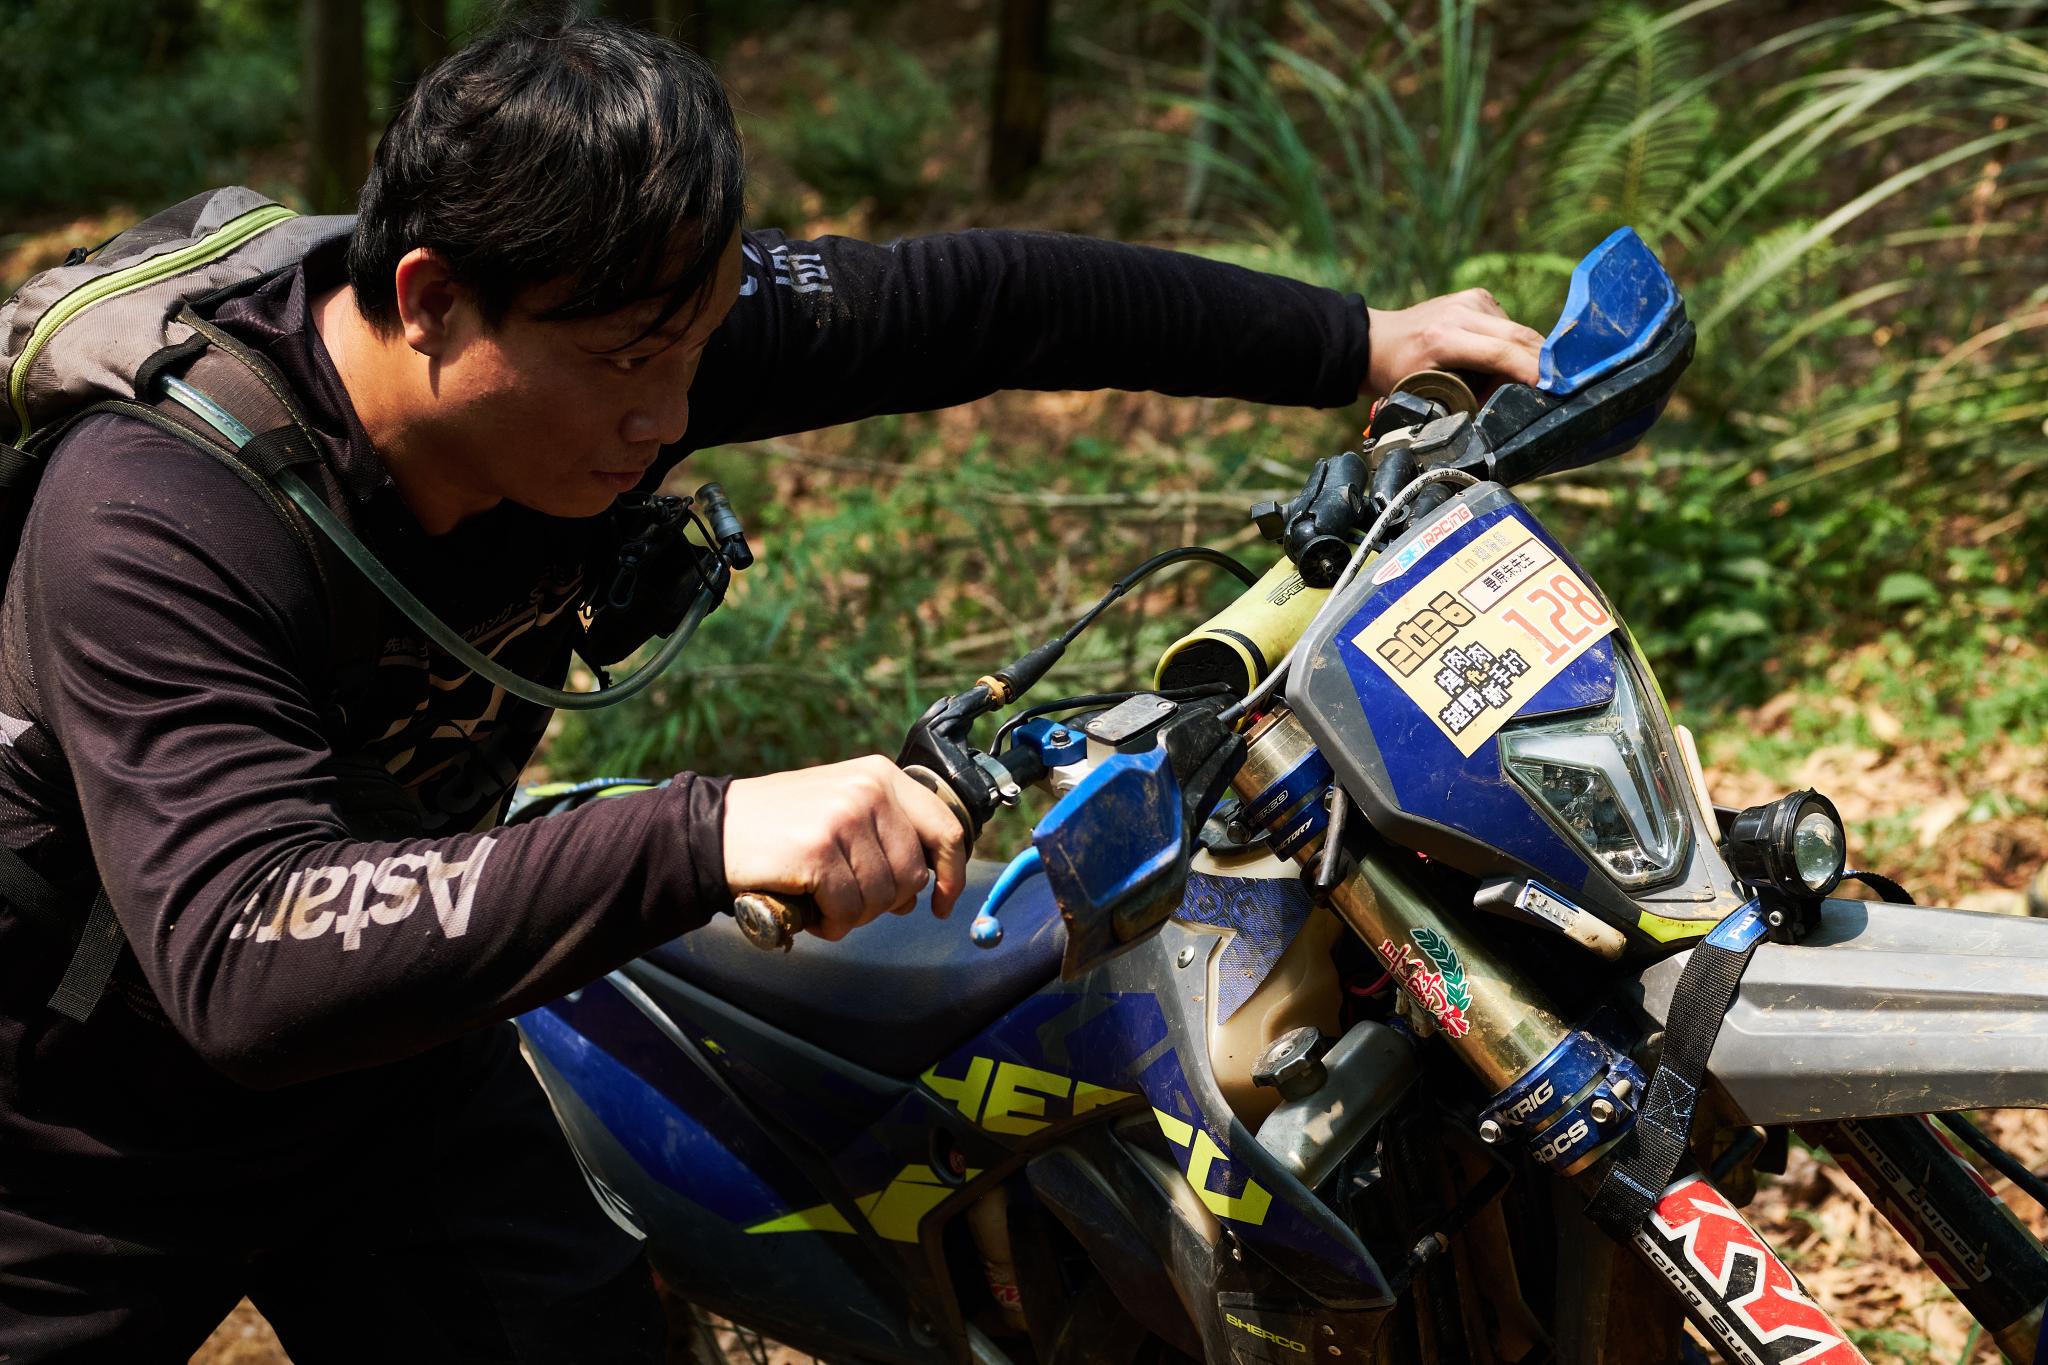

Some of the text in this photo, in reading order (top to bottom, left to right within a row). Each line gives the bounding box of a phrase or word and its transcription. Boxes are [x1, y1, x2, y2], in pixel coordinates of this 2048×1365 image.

[1502, 574, 1608, 665] 128
[1439, 649, 1530, 735] 越野新手村
[1636, 1234, 1703, 1307] acing
[1908, 1187, 1992, 1284] Racing
[1225, 1312, 1307, 1353] SHERCO
